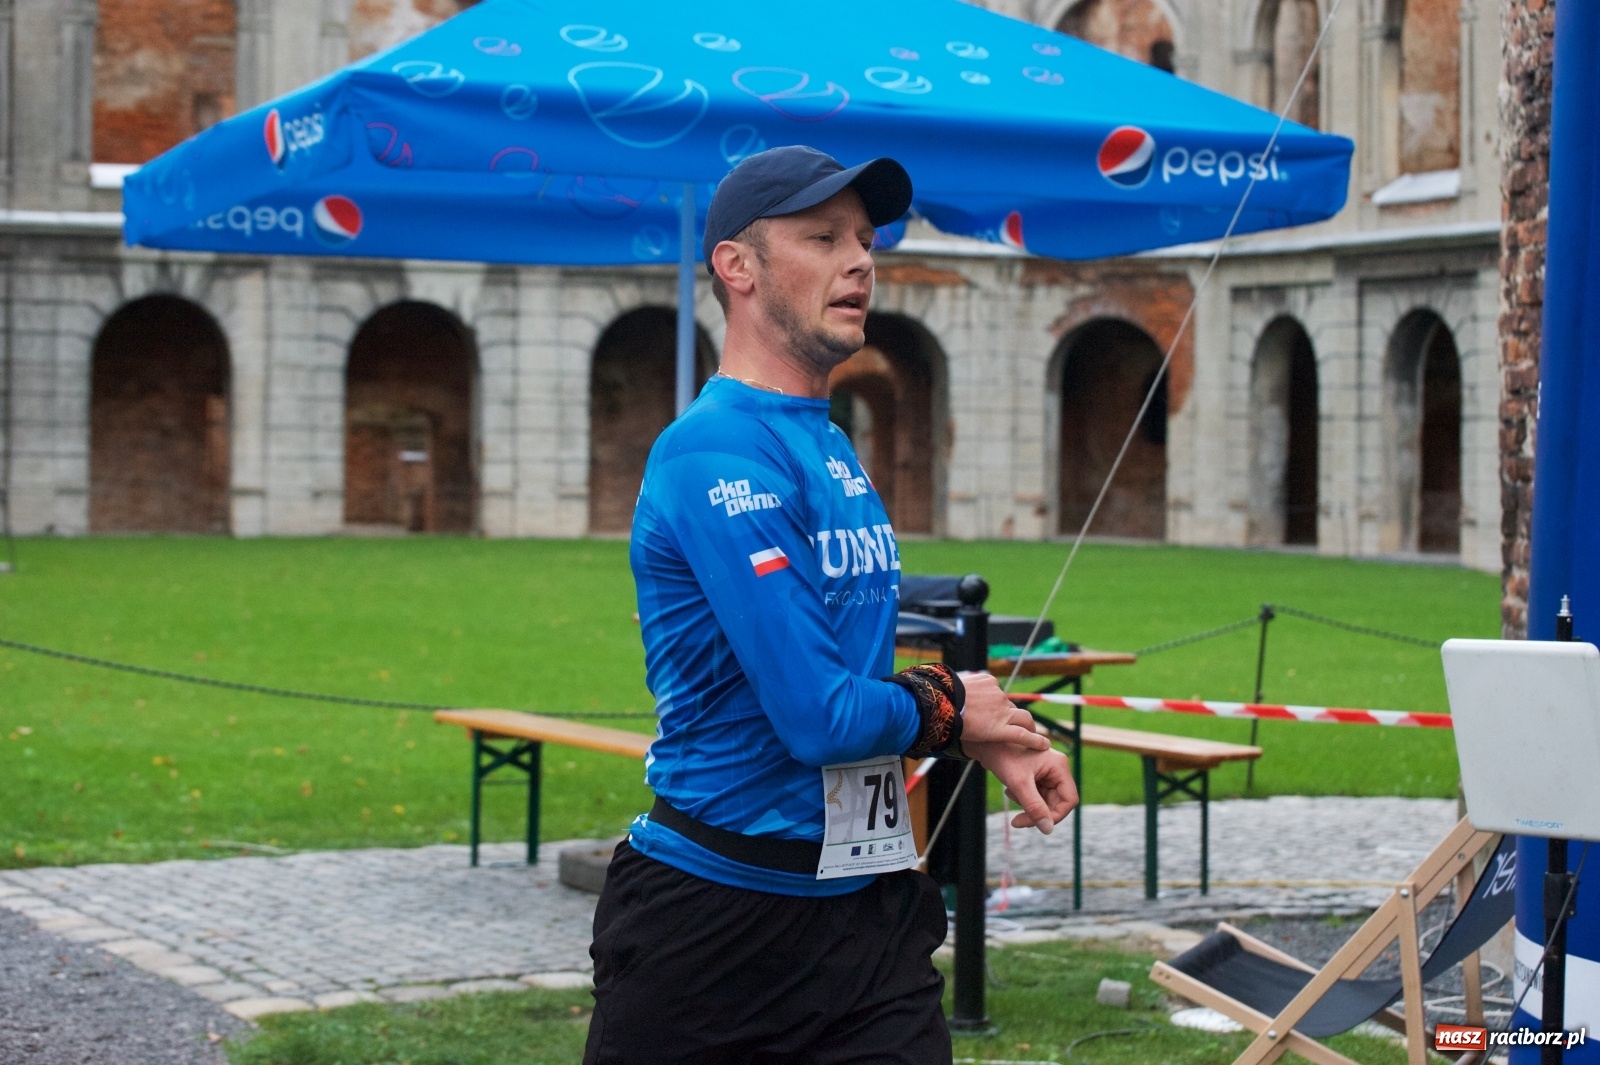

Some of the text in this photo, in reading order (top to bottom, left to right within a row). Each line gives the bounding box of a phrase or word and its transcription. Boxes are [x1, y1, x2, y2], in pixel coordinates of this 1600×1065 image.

[1162, 145, 1280, 187] pepsi
[707, 478, 751, 507] eko
[864, 771, 899, 831] 79
